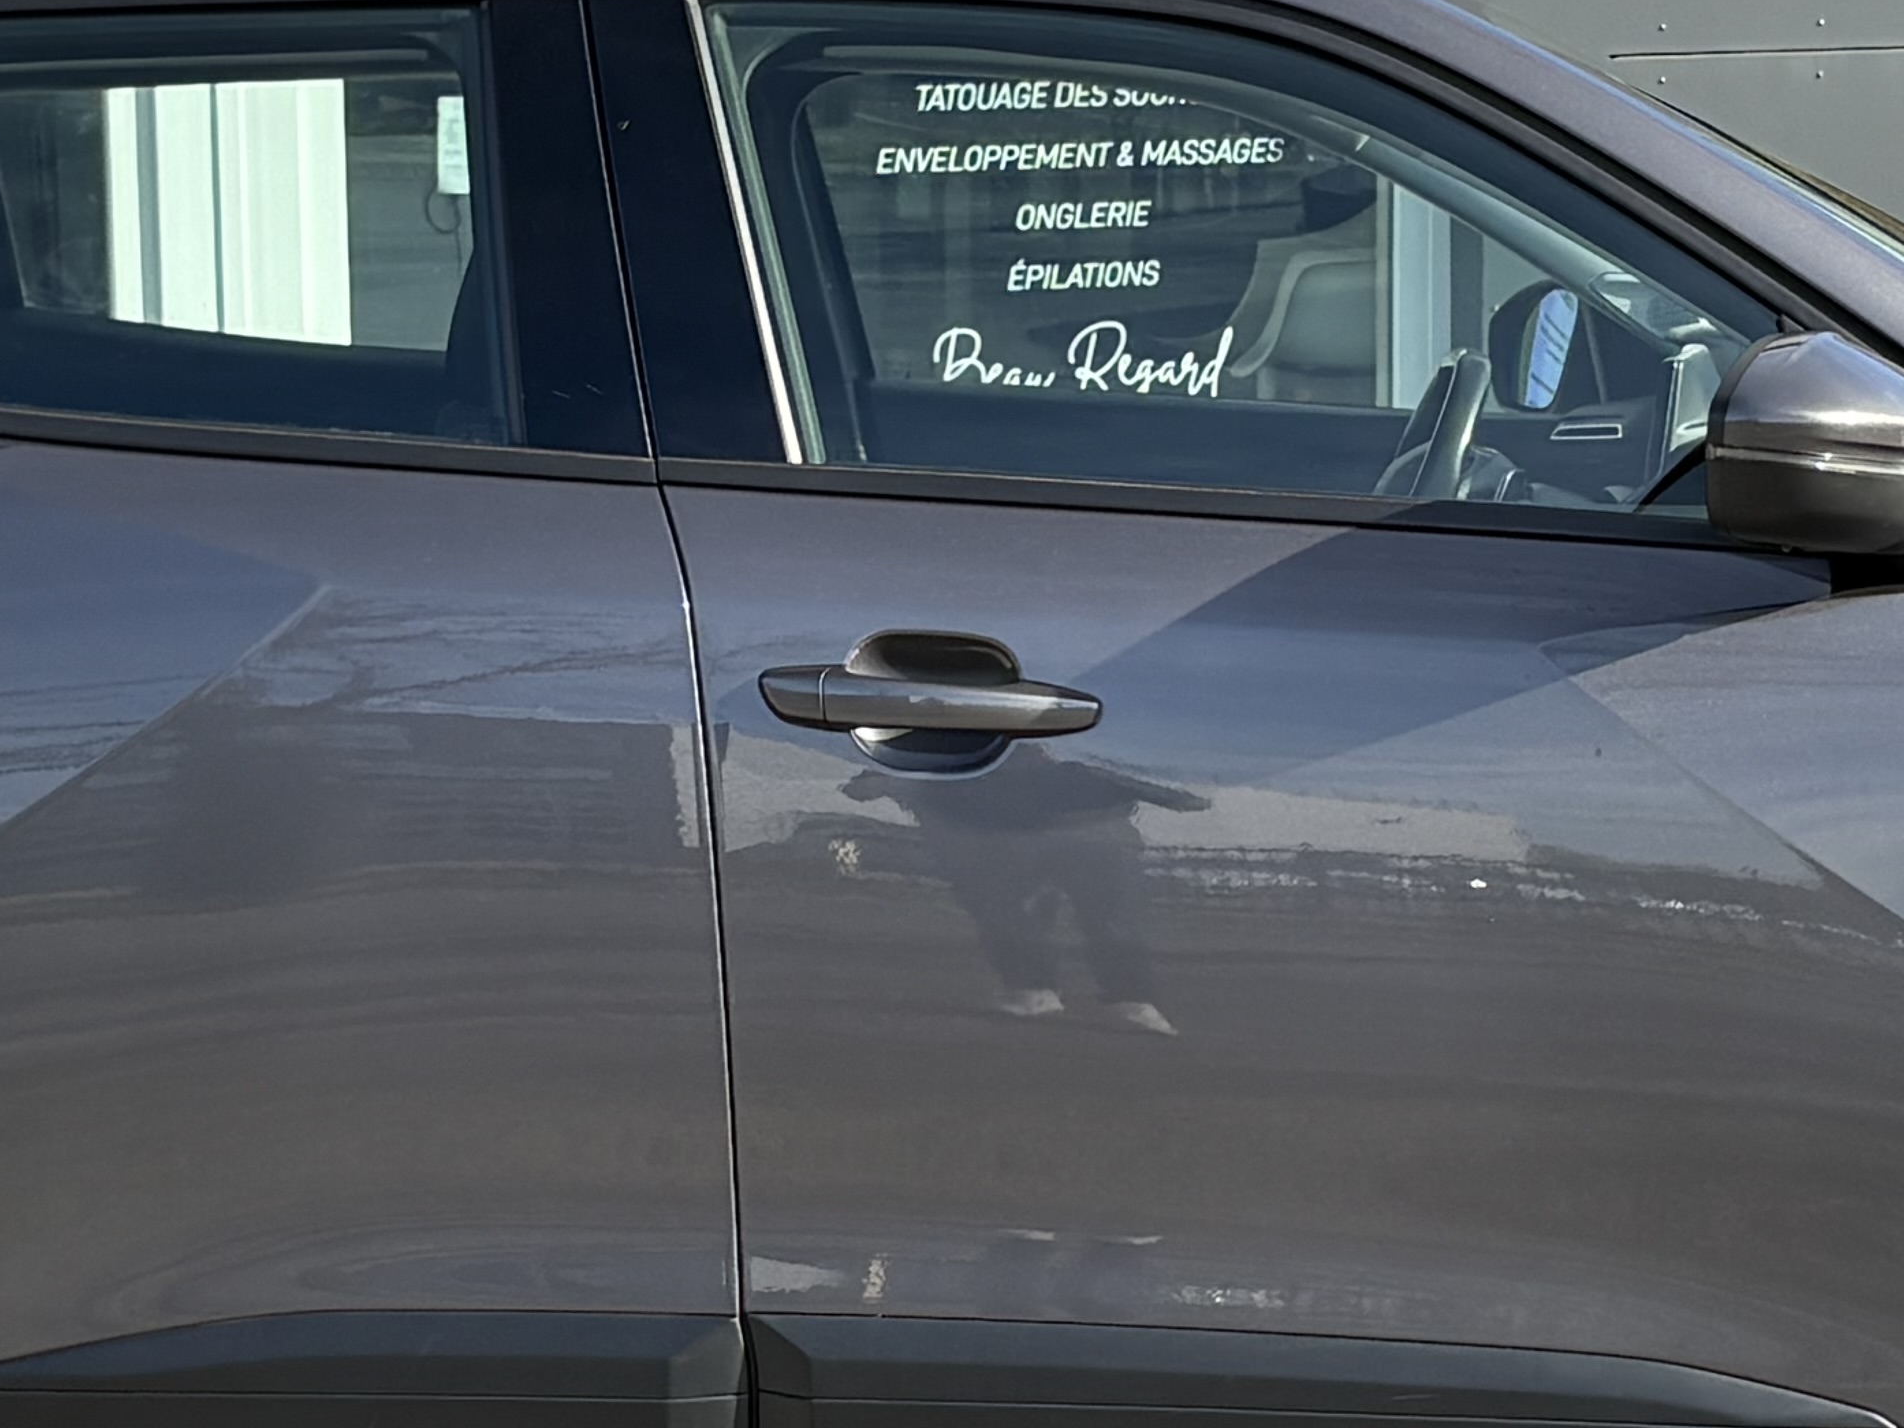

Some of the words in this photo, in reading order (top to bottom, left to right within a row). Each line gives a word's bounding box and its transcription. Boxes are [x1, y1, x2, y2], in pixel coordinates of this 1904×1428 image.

[914, 80, 1051, 113] TATOUAGE
[876, 141, 1114, 175] ENVELOPPEMENT
[1115, 140, 1135, 168] &
[1141, 136, 1285, 167] MASSAGES
[1015, 200, 1153, 232] ONGLERIE
[1006, 257, 1161, 292] ÉPILATIONS
[1067, 320, 1234, 398] Regard
